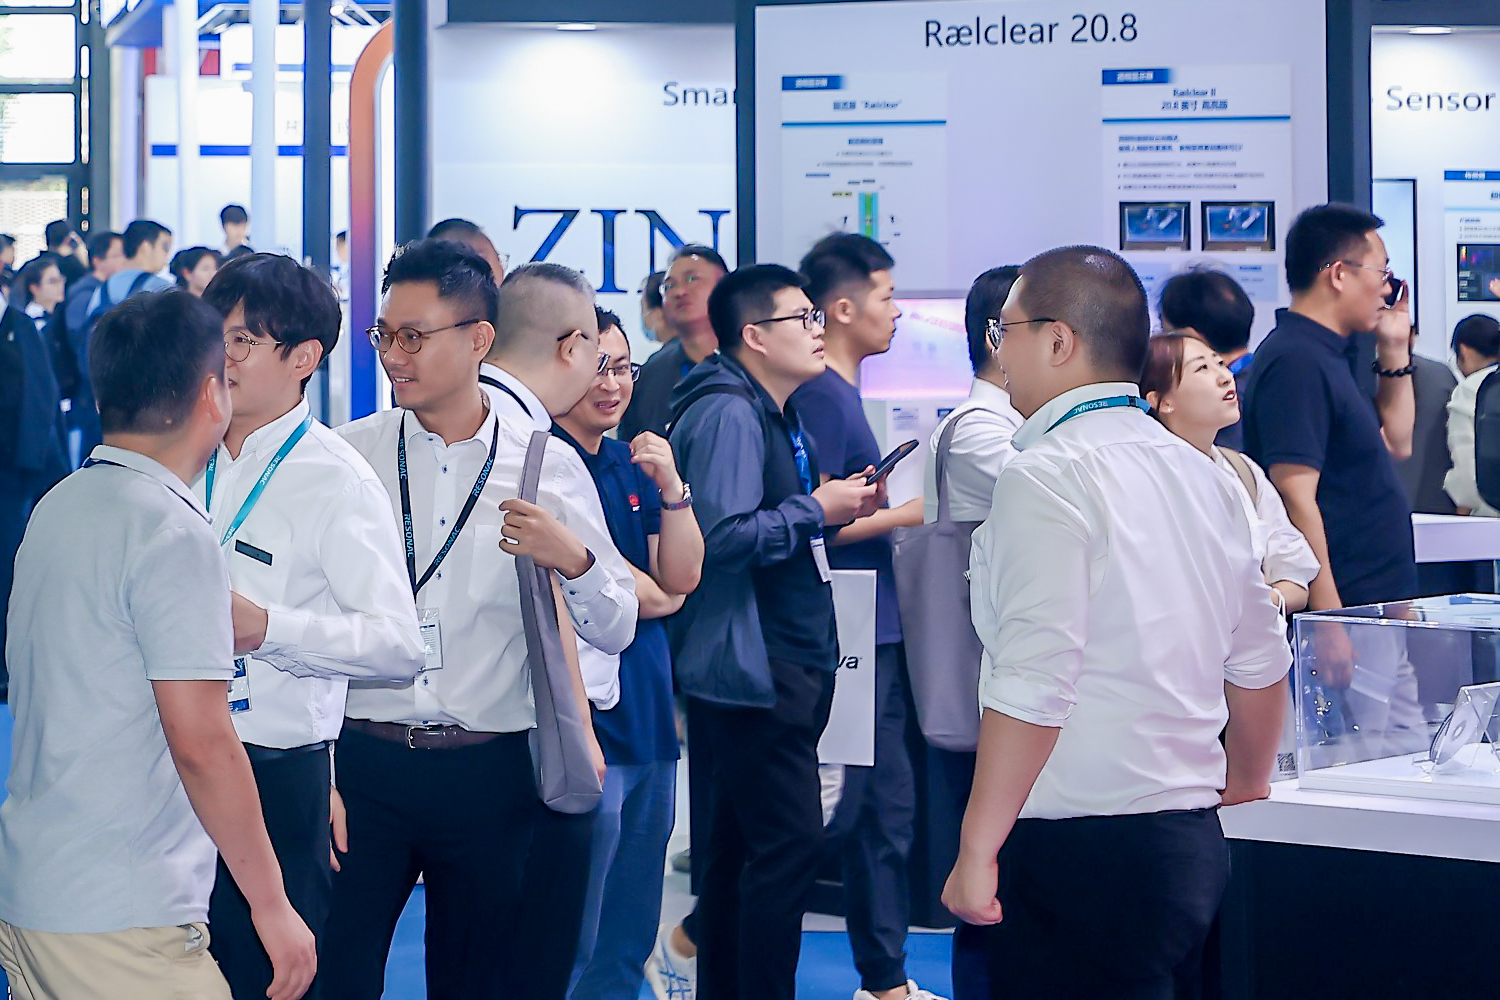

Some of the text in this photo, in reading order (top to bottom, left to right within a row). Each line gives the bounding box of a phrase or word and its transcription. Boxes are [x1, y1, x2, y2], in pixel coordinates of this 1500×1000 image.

[925, 12, 1138, 48] Rælclear 20.8
[1386, 85, 1497, 112] Sensor
[260, 455, 282, 485] RESONAC
[472, 456, 494, 497] RESONAC
[403, 513, 415, 558] RESONAC
[433, 525, 461, 567] RESONAC
